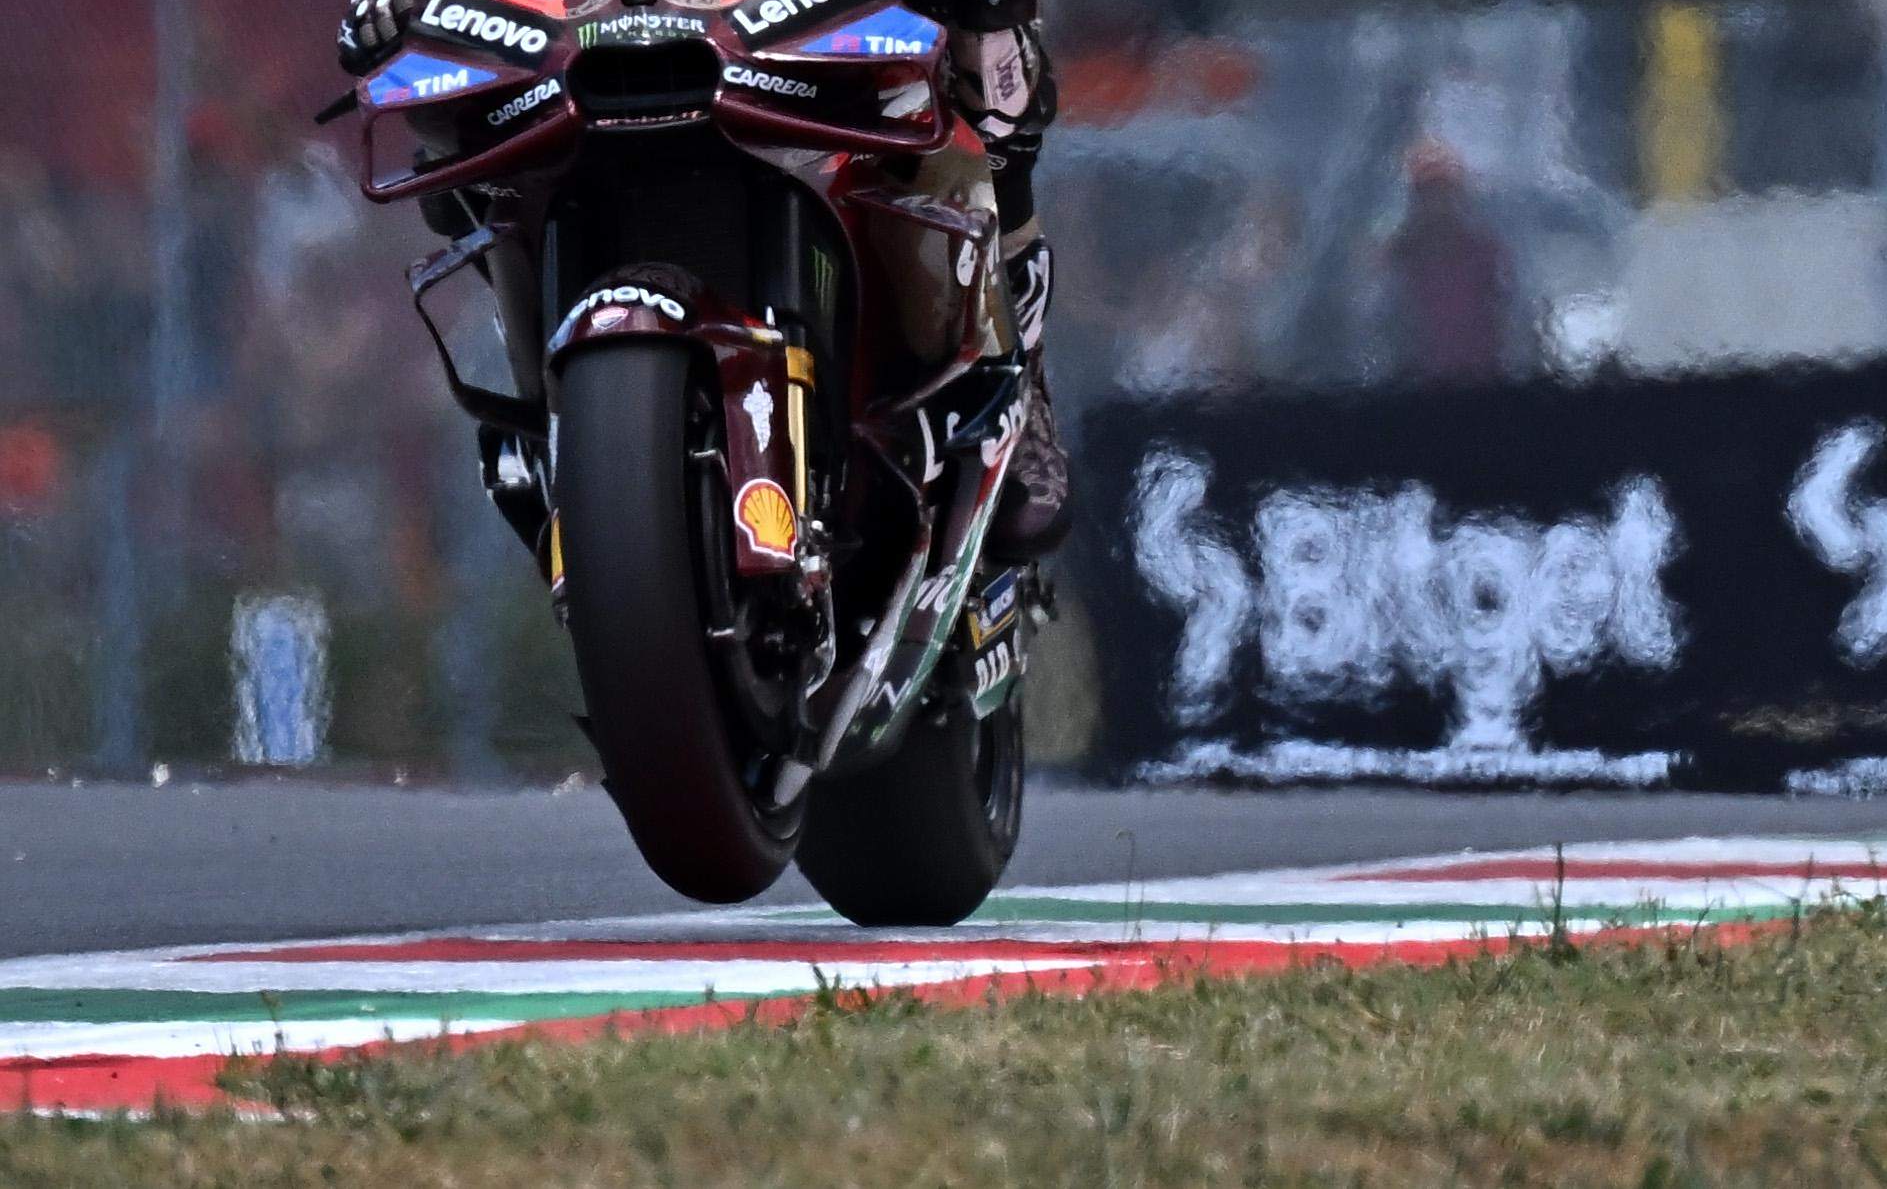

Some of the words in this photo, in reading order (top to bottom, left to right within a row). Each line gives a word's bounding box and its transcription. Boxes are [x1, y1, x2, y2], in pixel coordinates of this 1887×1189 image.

[600, 13, 705, 34] MONSTER
[865, 36, 922, 55] TIM
[414, 69, 469, 98] TIM
[723, 66, 818, 99] CARRERA
[487, 78, 562, 126] CARRERA
[1250, 475, 1684, 748] Bitget
